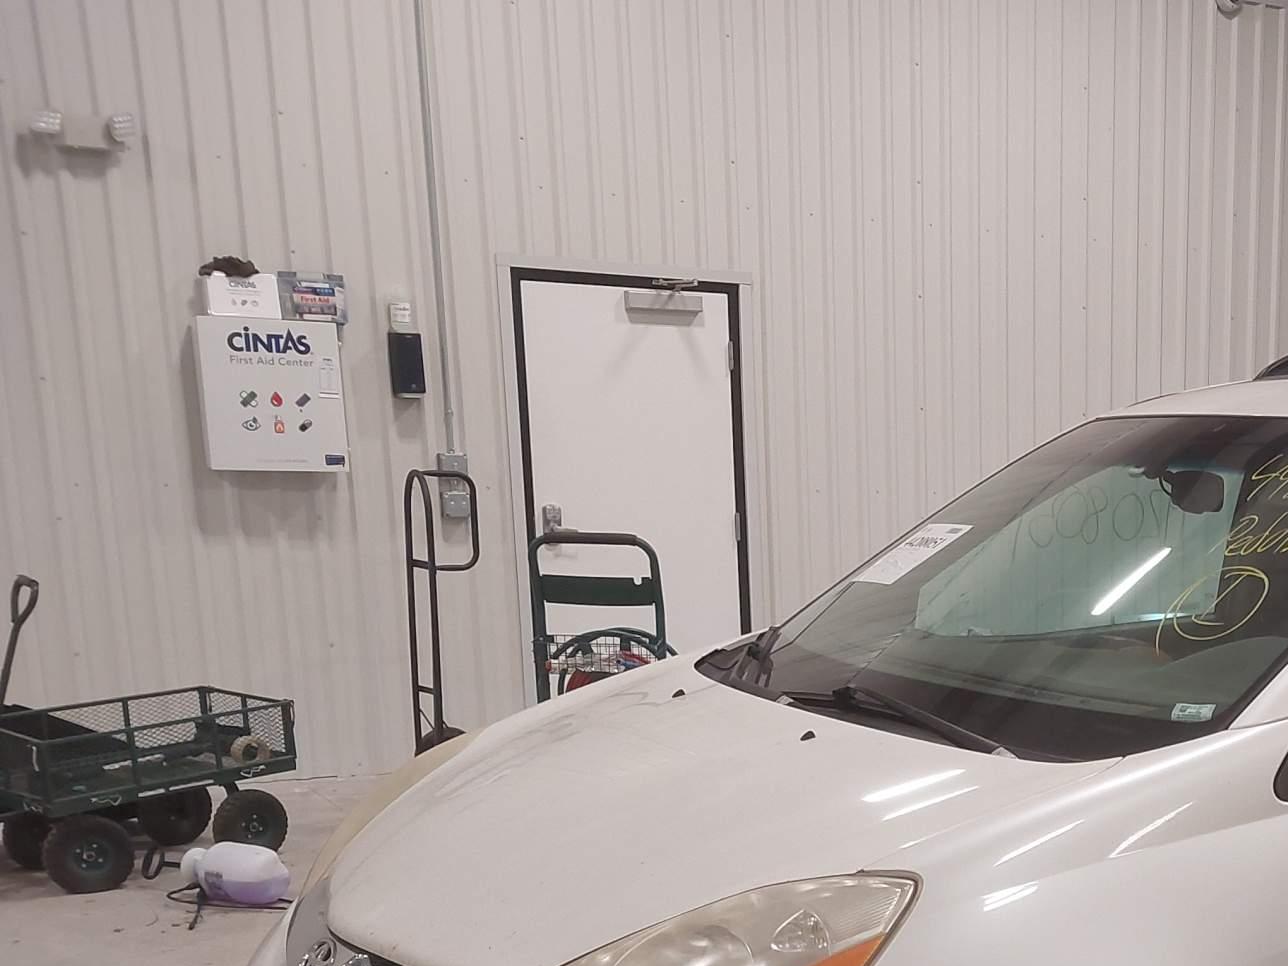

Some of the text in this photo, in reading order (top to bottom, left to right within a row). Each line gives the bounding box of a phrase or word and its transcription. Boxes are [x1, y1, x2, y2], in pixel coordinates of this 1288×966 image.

[229, 354, 254, 366] First
[257, 355, 275, 367] Aid
[278, 357, 314, 368] Center
